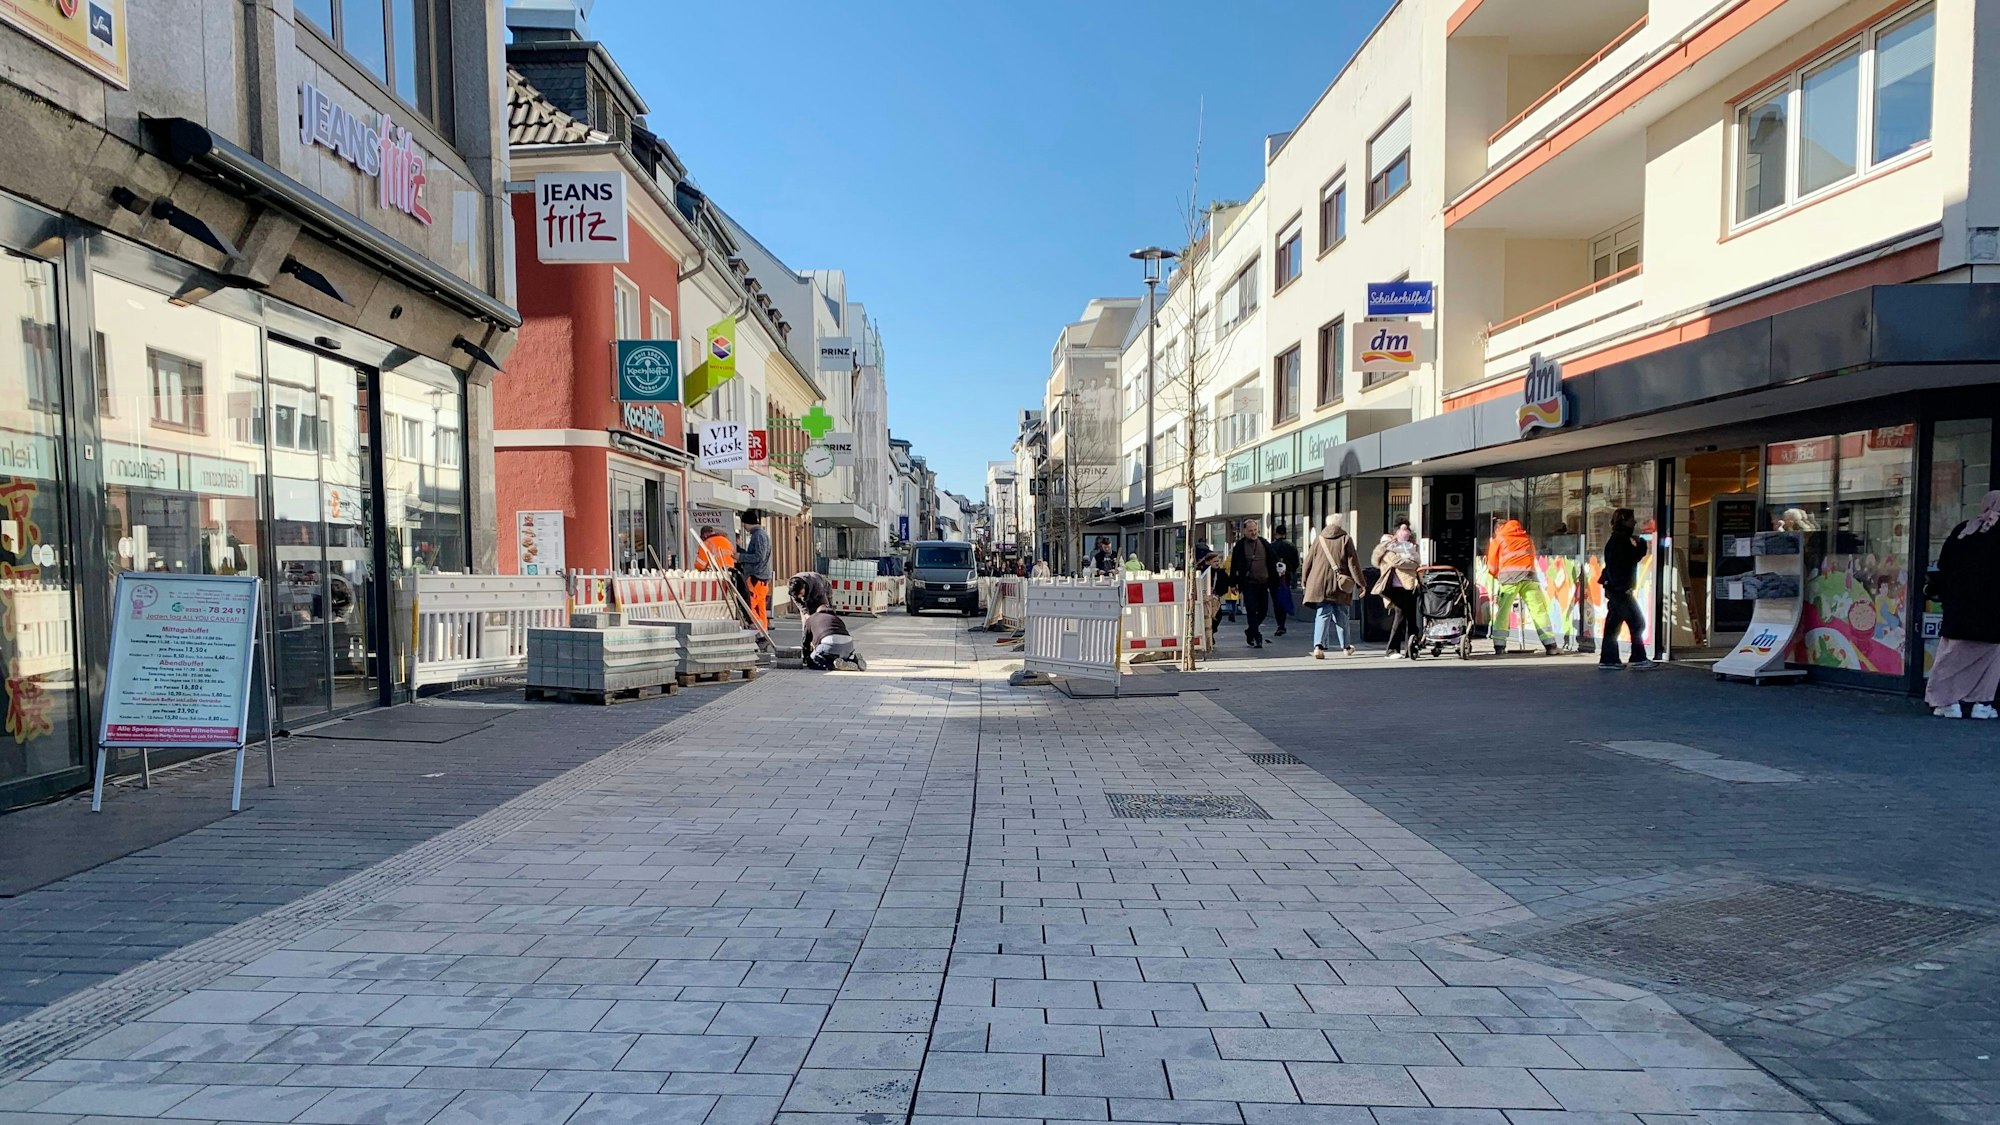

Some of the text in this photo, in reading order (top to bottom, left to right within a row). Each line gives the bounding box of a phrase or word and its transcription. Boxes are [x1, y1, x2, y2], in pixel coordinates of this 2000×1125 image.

[300, 80, 432, 225] JEANS fritz
[543, 183, 613, 206] JEANS
[543, 204, 618, 248] fritz
[1370, 290, 1431, 306] Schülerhilfe!
[1370, 328, 1408, 350] dm
[1525, 356, 1556, 404] dm
[624, 402, 665, 440] Kochlöffel
[710, 425, 738, 440] VIP
[702, 438, 743, 457] Kiosk
[708, 456, 743, 466] EUSKIRCHEN
[1751, 628, 1778, 647] dm
[1926, 624, 1934, 633] P
